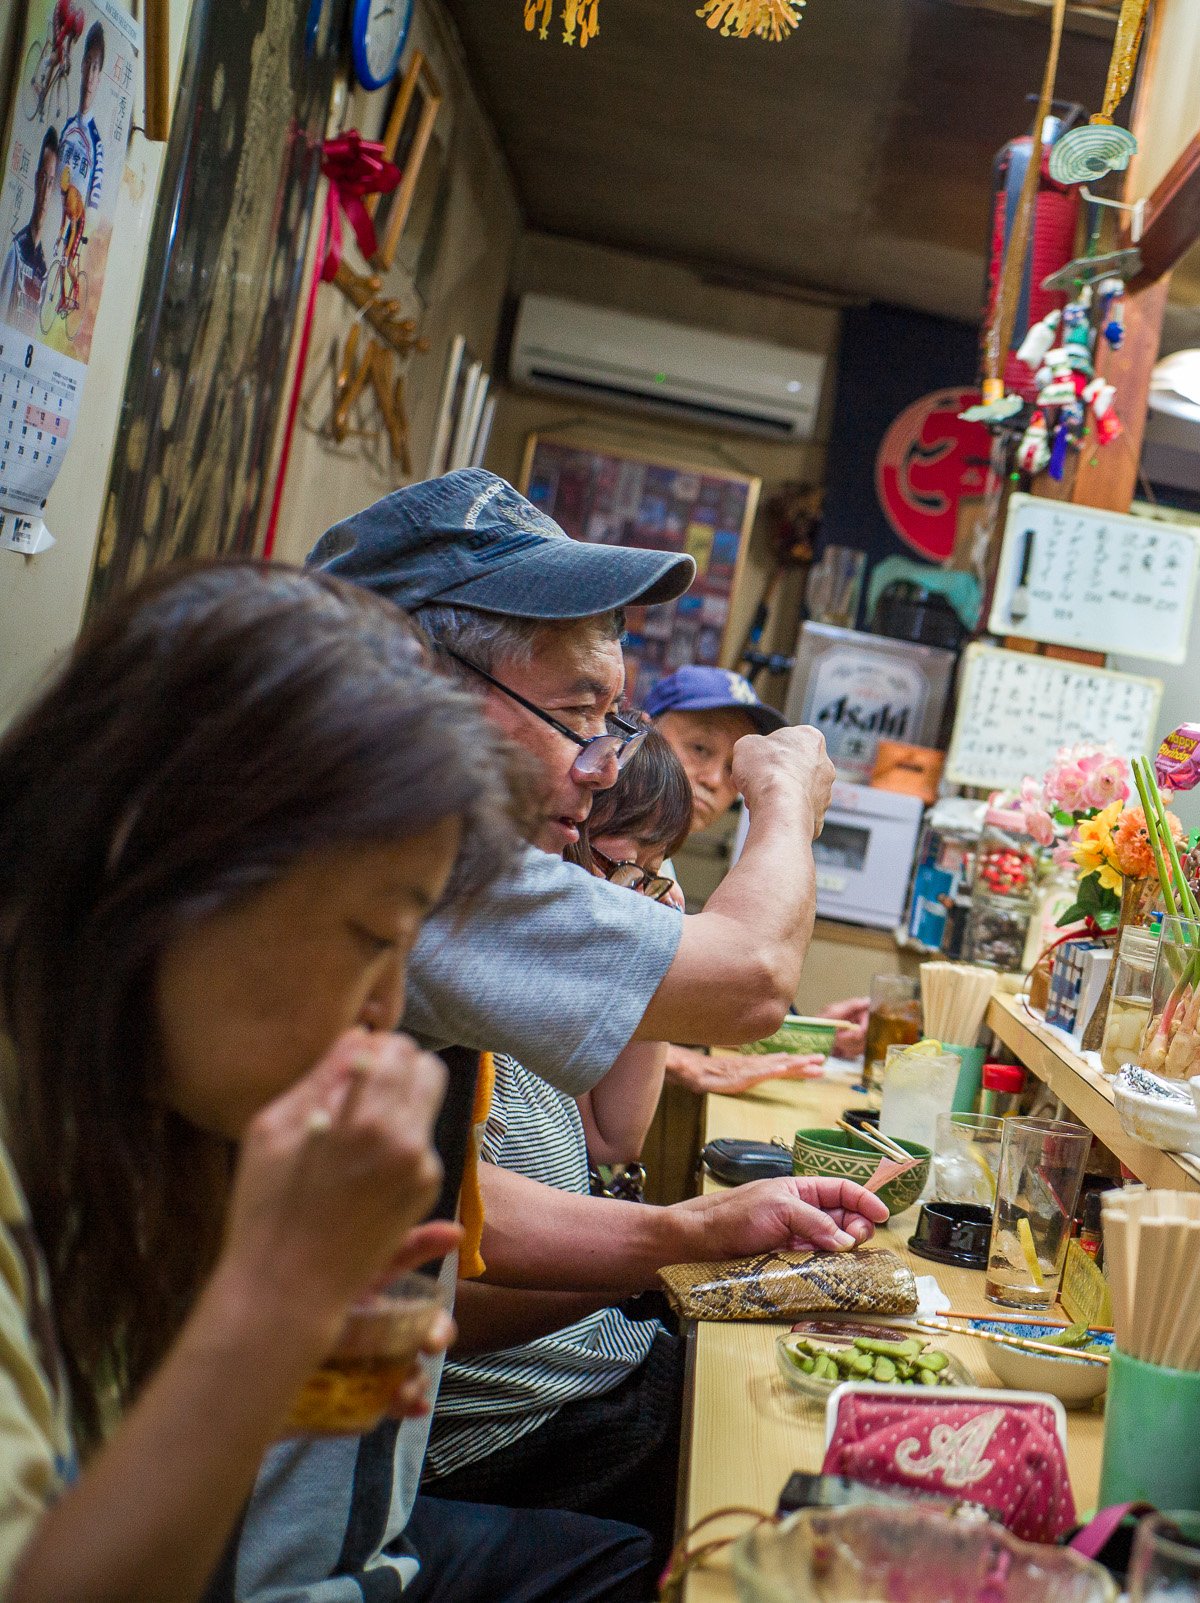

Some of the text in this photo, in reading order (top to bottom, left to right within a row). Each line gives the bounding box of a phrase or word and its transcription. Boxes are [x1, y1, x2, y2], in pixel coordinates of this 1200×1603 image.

[24, 343, 34, 369] 8
[816, 694, 912, 738] Asahi
[1167, 731, 1199, 751] Happy
